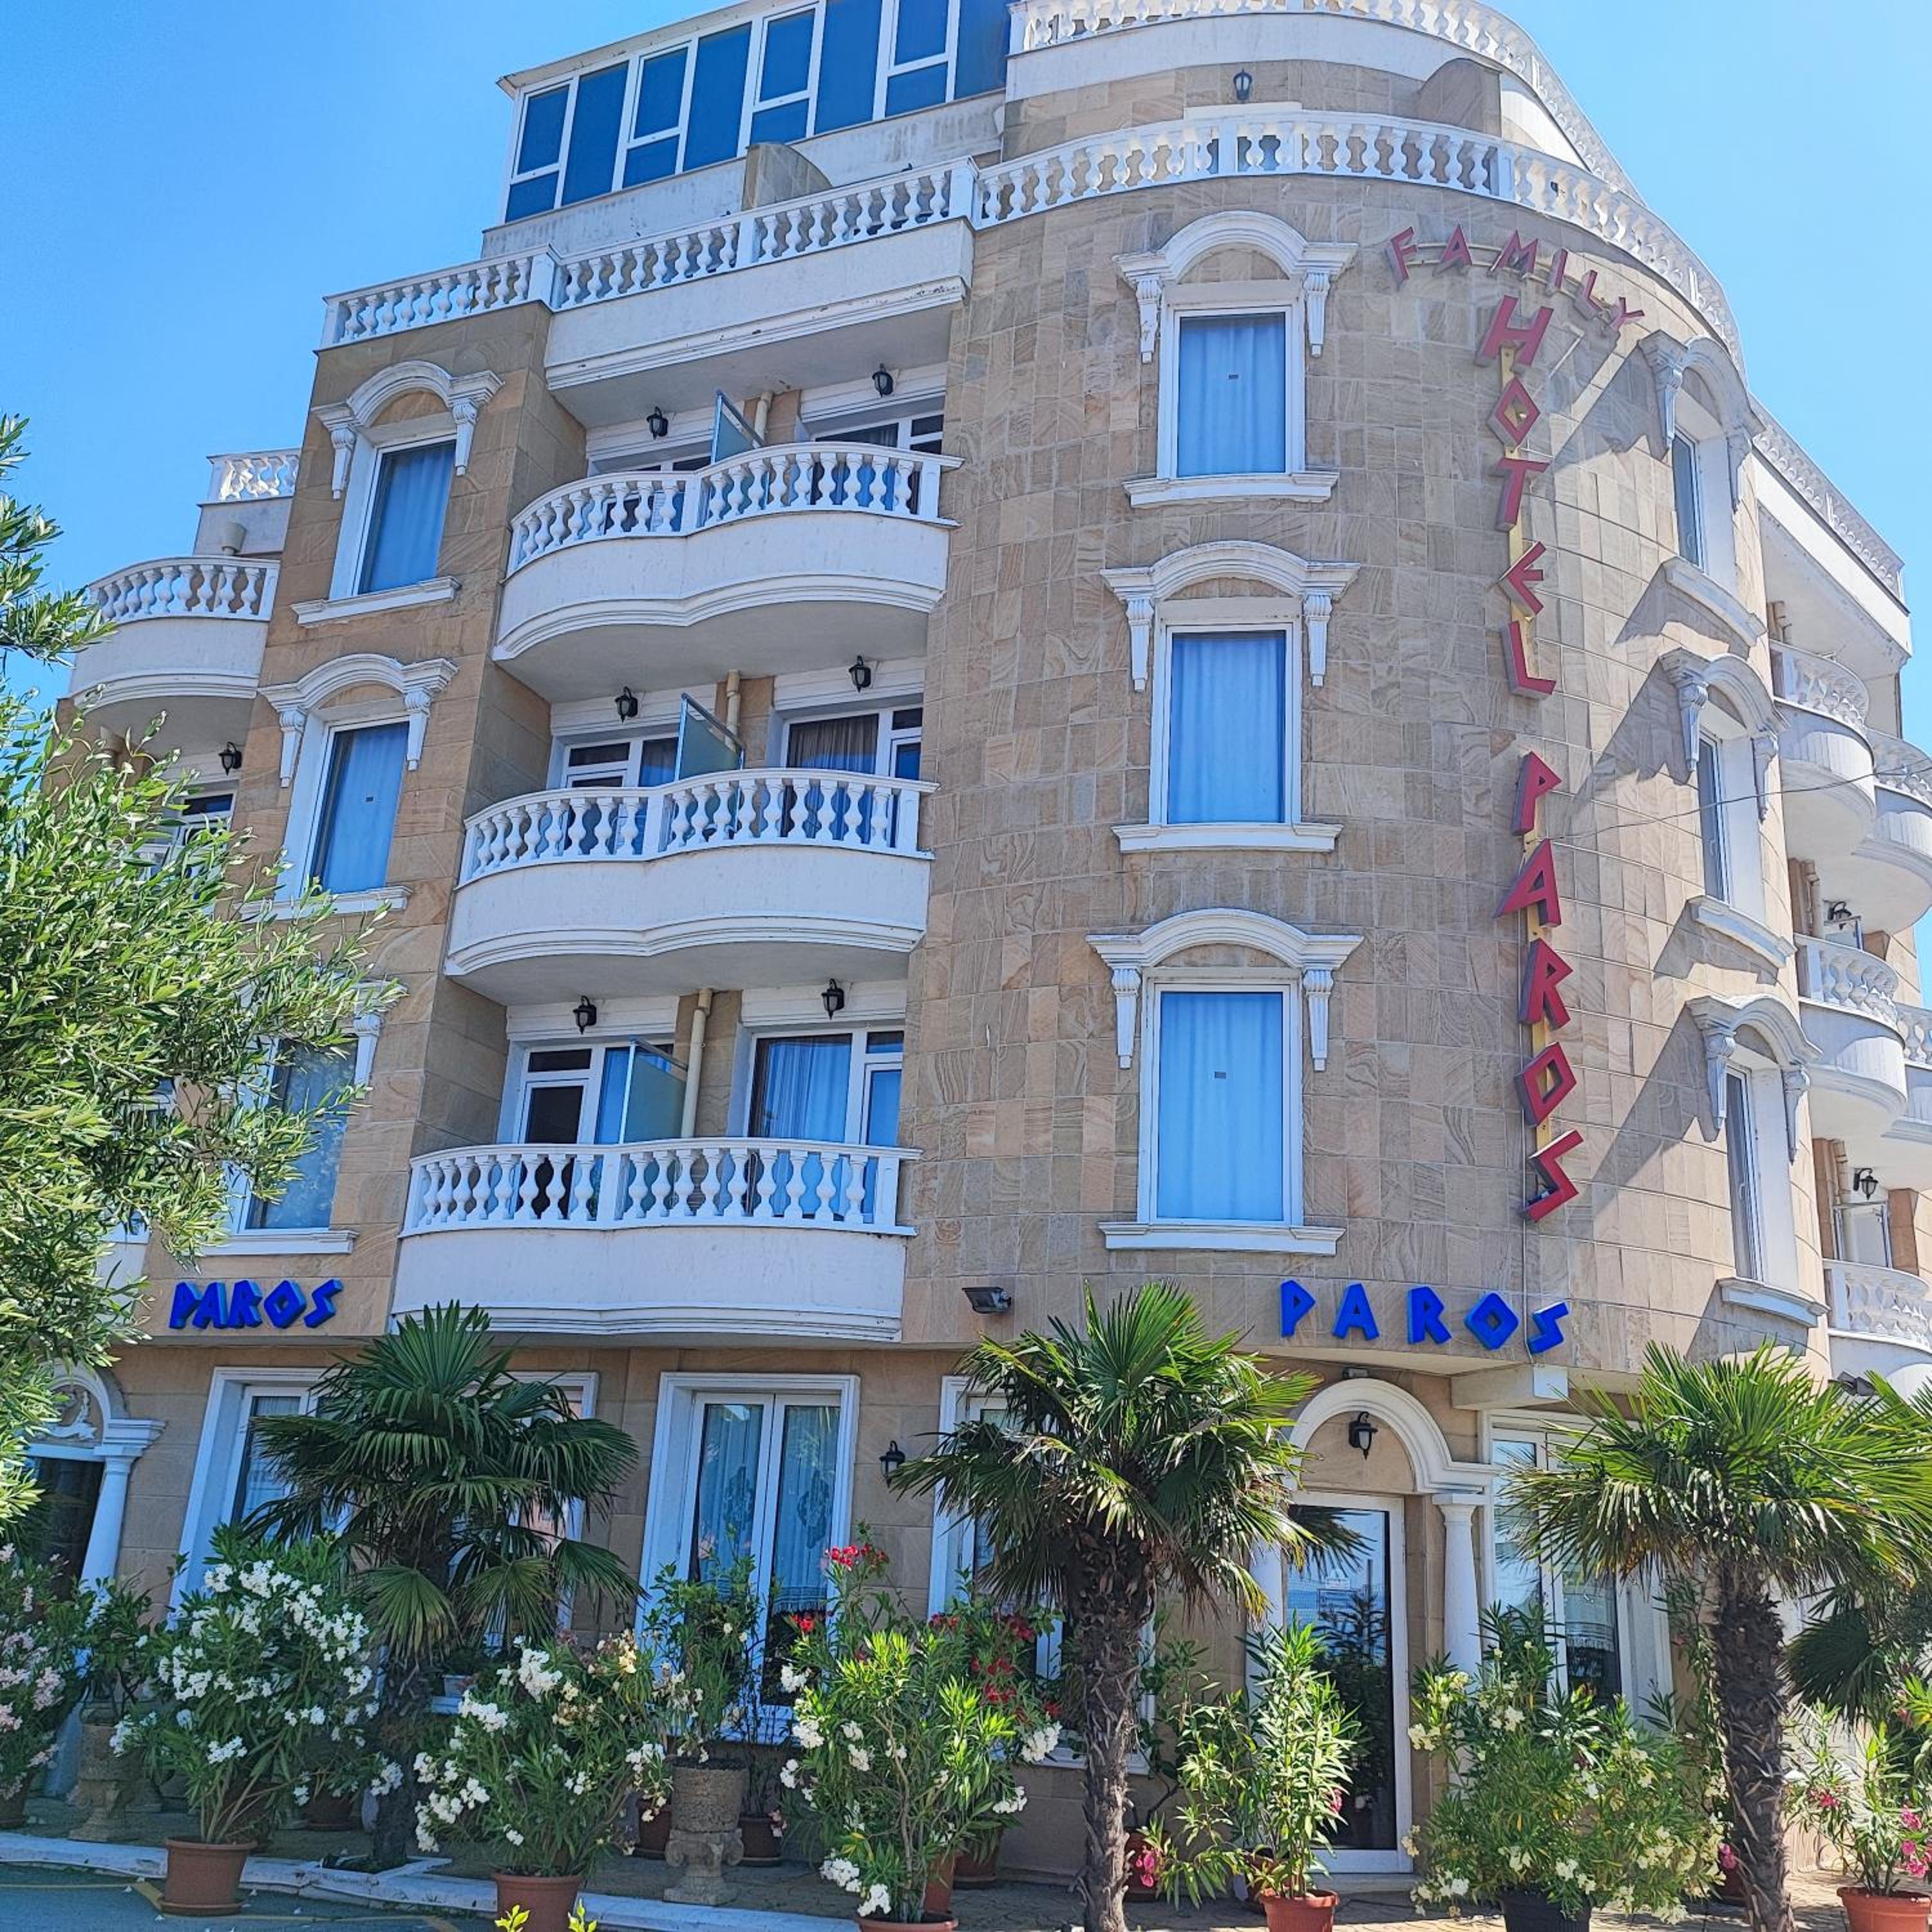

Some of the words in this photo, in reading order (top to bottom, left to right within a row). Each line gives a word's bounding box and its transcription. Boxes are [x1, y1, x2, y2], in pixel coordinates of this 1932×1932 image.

[1387, 225, 1644, 330] FAMILY
[1477, 295, 1556, 697] HOTEL
[1493, 751, 1584, 1222] PAROS
[169, 1279, 343, 1329] PAROS
[1280, 1280, 1569, 1353] PAROS
